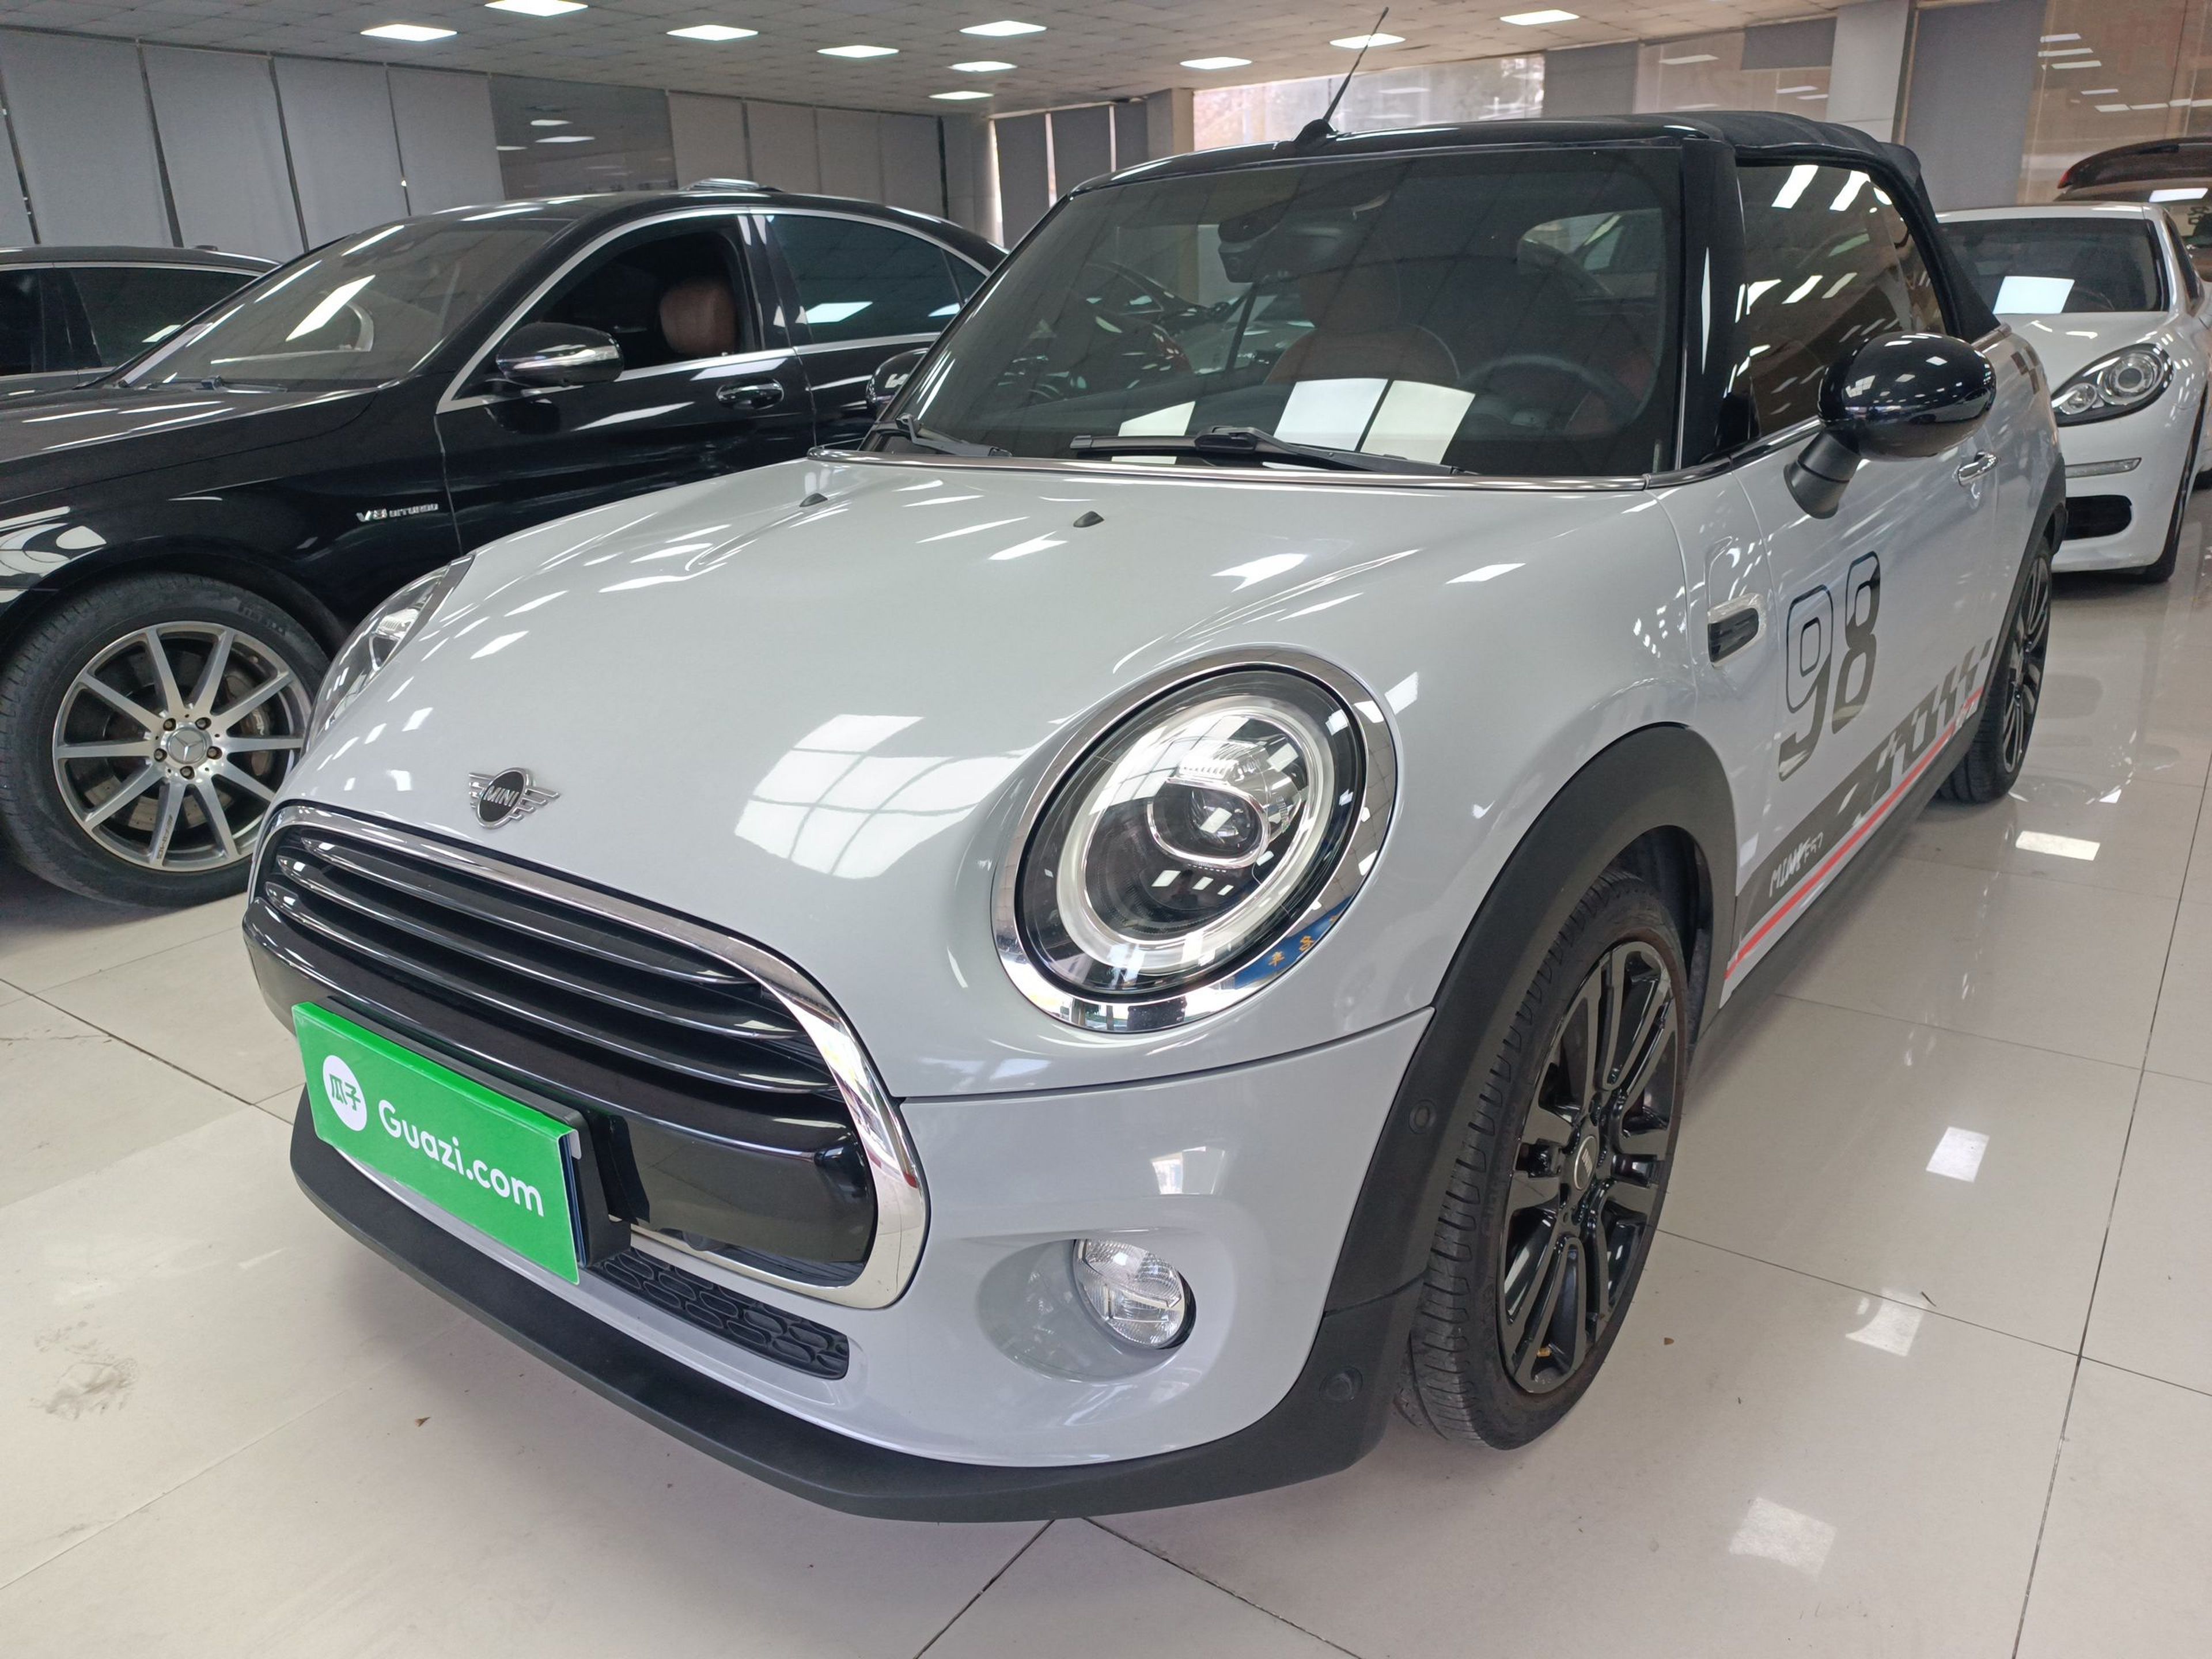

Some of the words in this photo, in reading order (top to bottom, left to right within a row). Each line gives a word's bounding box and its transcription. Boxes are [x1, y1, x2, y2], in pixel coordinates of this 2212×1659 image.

[356, 508, 387, 522] V8
[1778, 550, 1881, 782] 98
[483, 785, 520, 807] MINI
[329, 1073, 361, 1111] 瓜子
[378, 1099, 544, 1217] Guazi.com
